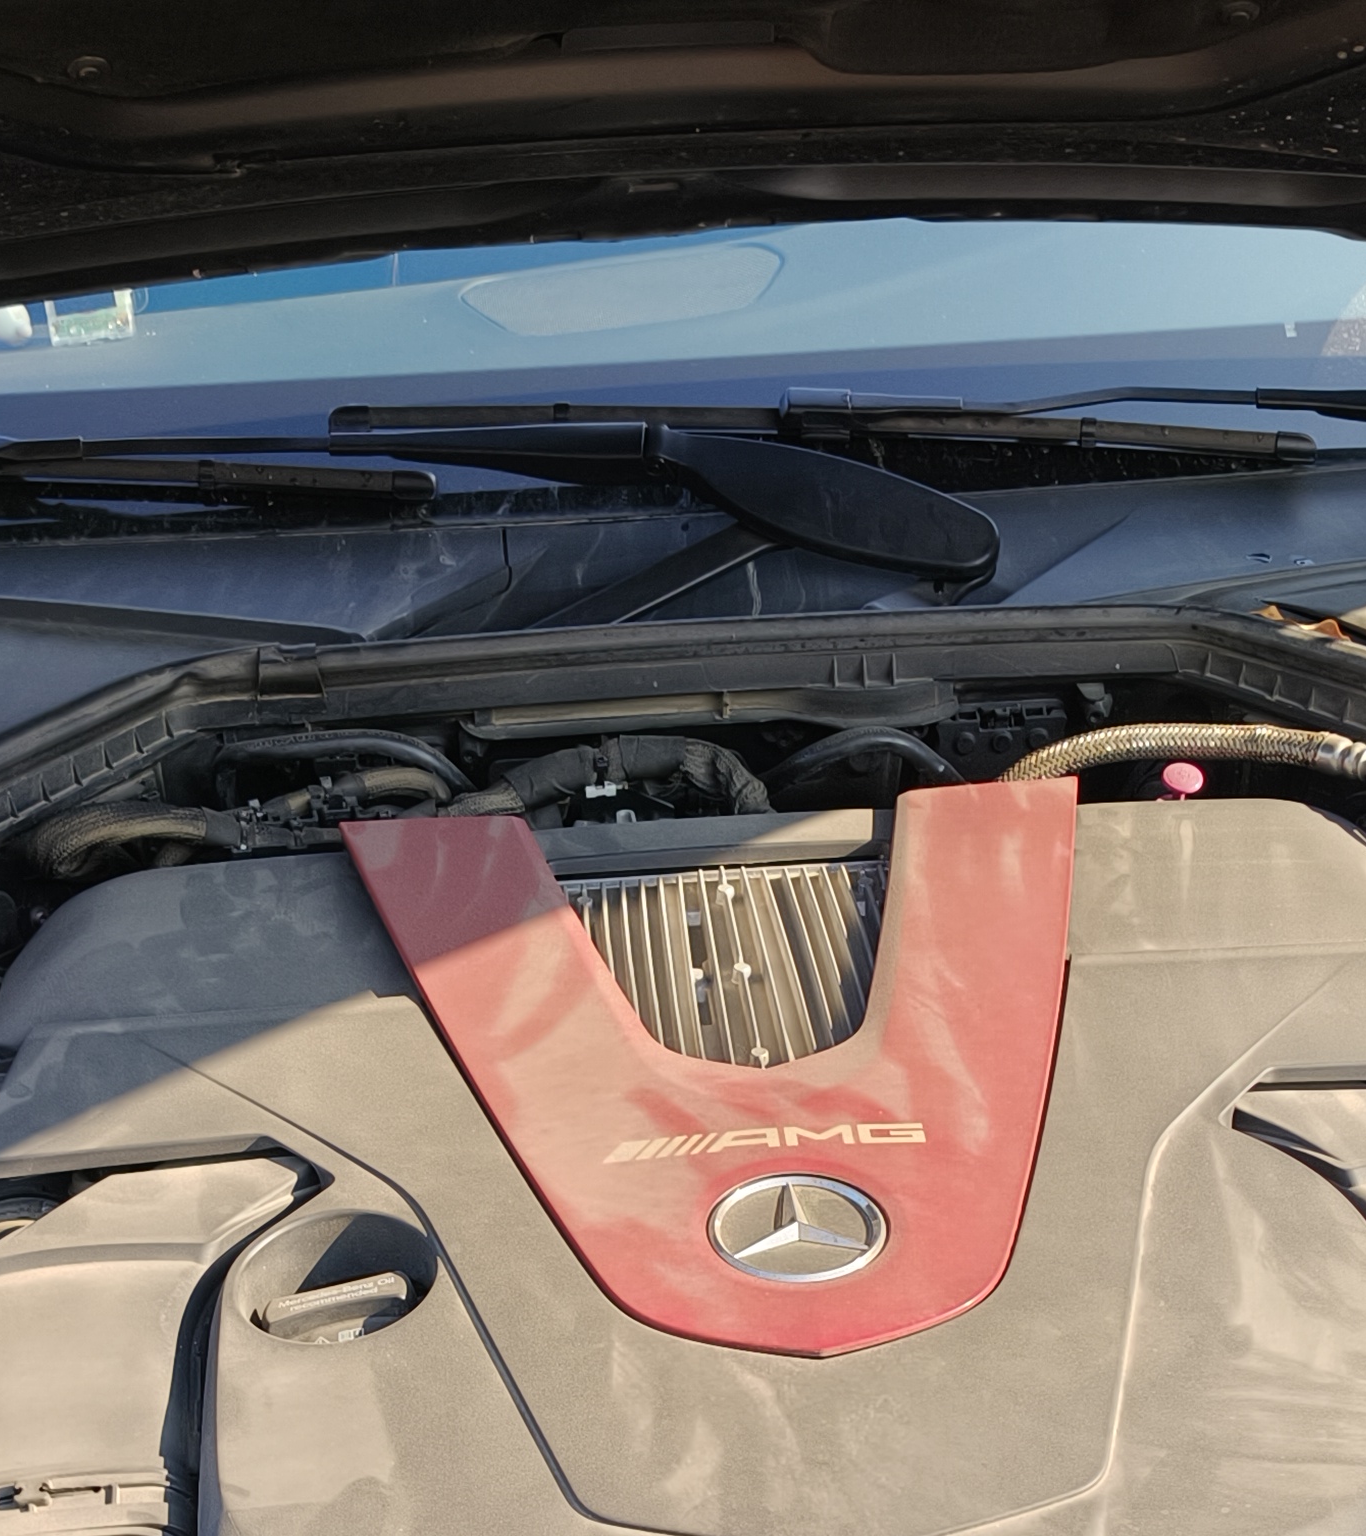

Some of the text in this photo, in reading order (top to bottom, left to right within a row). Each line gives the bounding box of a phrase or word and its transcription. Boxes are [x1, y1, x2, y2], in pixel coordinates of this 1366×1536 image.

[706, 1123, 926, 1153] AMG
[278, 1277, 395, 1308] Mercedes-Benz Oil
[290, 1287, 378, 1311] recommended
